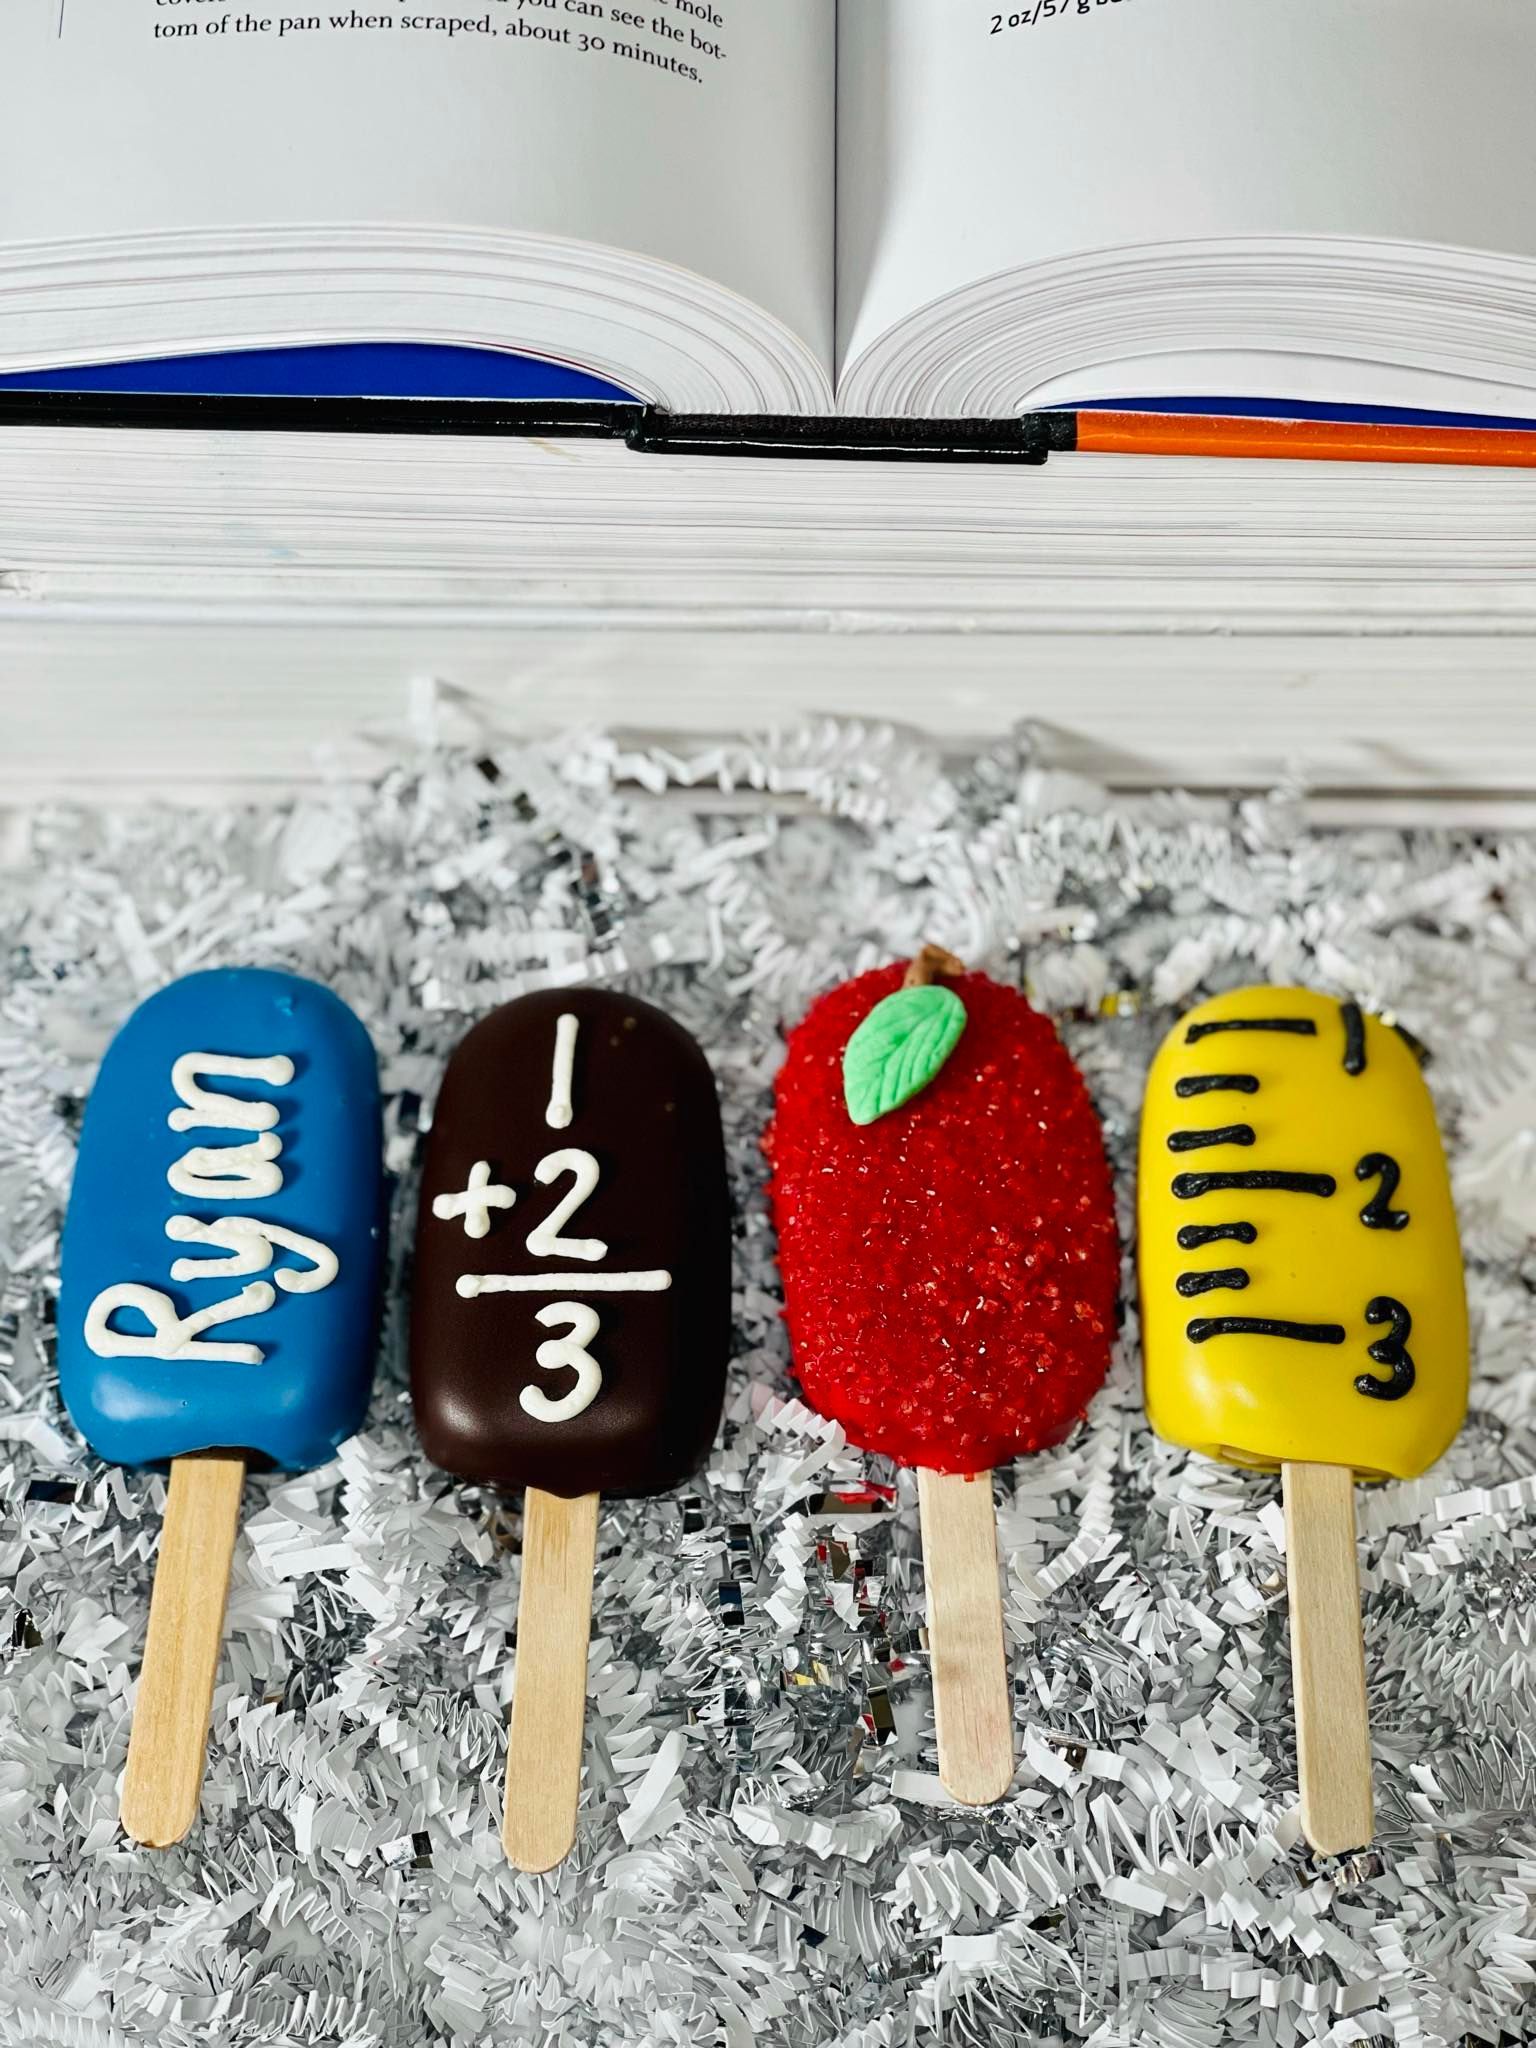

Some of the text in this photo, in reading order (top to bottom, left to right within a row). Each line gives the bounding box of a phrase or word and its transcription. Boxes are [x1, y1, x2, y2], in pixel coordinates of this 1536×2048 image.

[154, 9, 703, 83] tom of the pan when scraped, about 30 minutes.
[564, 0, 604, 18] can
[610, 8, 645, 29] see
[652, 16, 685, 42] the
[690, 28, 727, 59] bot-
[675, 0, 723, 28] mole
[990, 15, 1003, 35] 2
[83, 1051, 340, 1366] Ryan
[1354, 1152, 1411, 1232] 2
[518, 1300, 603, 1424] 3
[1353, 1295, 1417, 1402] 3
